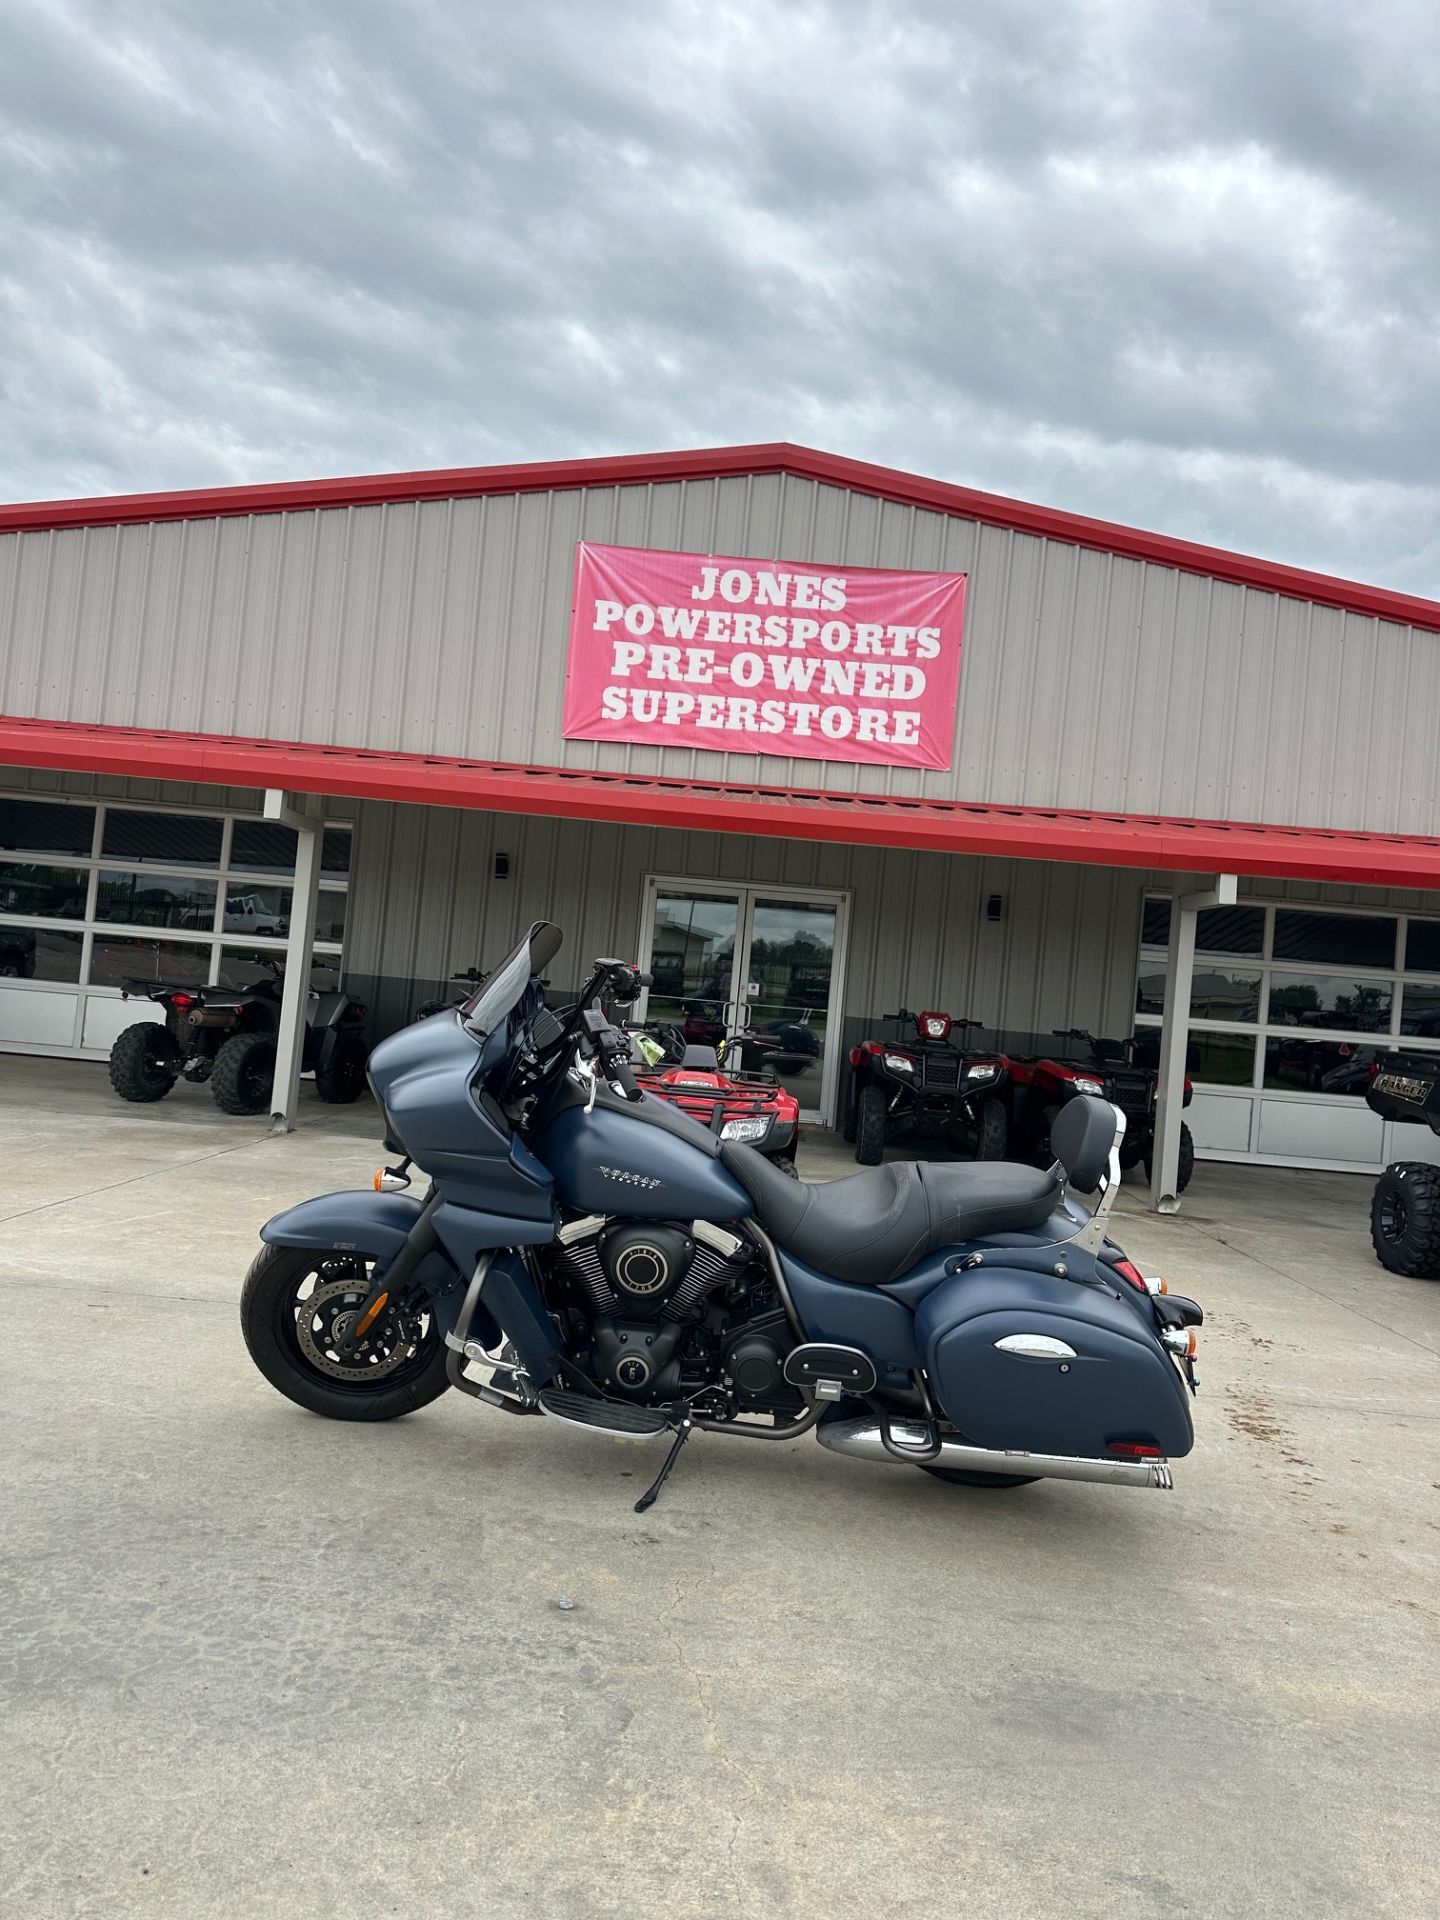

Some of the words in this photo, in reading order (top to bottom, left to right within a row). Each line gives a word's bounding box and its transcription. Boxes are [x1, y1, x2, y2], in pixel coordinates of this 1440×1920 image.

[692, 567, 848, 611] JONES
[593, 600, 940, 659] POWERSPORTS
[611, 641, 926, 699] PRE-OWNED
[602, 686, 921, 745] SUPERSTORE
[1380, 1078, 1428, 1098] RANGER
